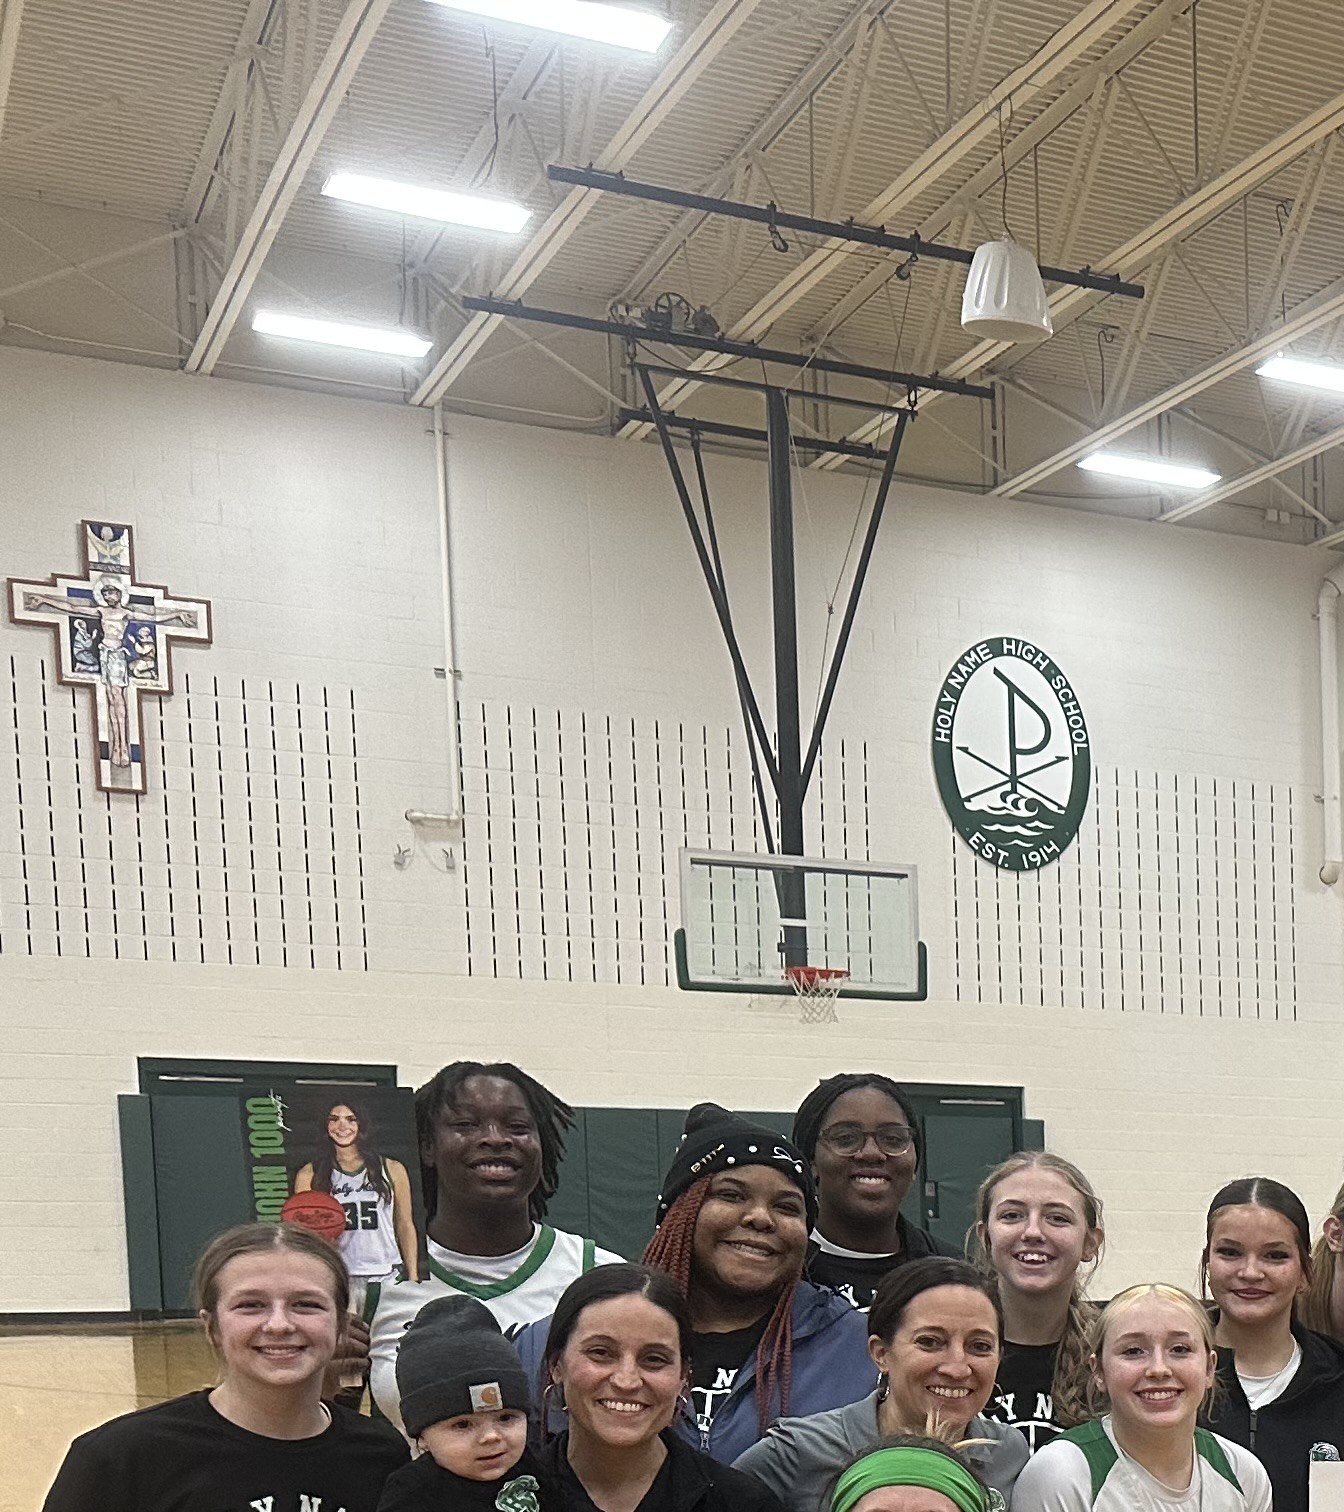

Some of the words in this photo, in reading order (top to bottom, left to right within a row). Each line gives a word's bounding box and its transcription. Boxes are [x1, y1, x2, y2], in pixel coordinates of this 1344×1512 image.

[935, 690, 958, 743] HOLY
[948, 643, 993, 689] NAME
[1003, 638, 1049, 671] HIGH
[1051, 675, 1088, 756] SCHOOL
[969, 832, 1009, 867] EST.
[1022, 840, 1061, 868] 1914
[245, 1097, 286, 1159] 1000
